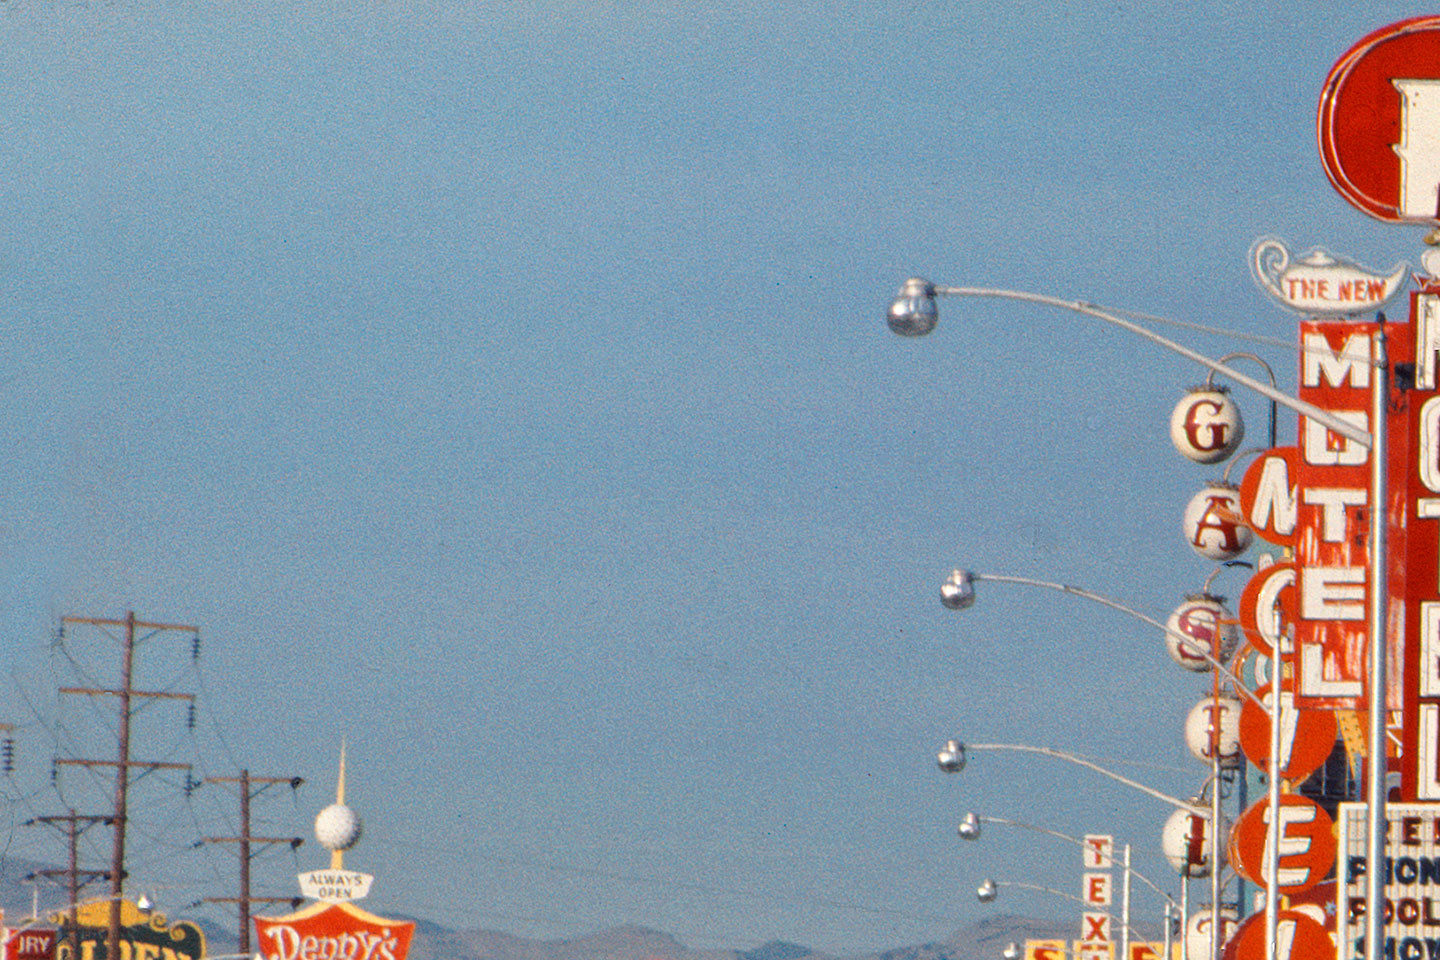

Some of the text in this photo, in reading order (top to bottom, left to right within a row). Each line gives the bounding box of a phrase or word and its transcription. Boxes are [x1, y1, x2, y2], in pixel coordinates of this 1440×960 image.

[1287, 278, 1388, 301] THE NEW
[309, 874, 363, 886] ALWAYS
[318, 887, 353, 898] OPEN
